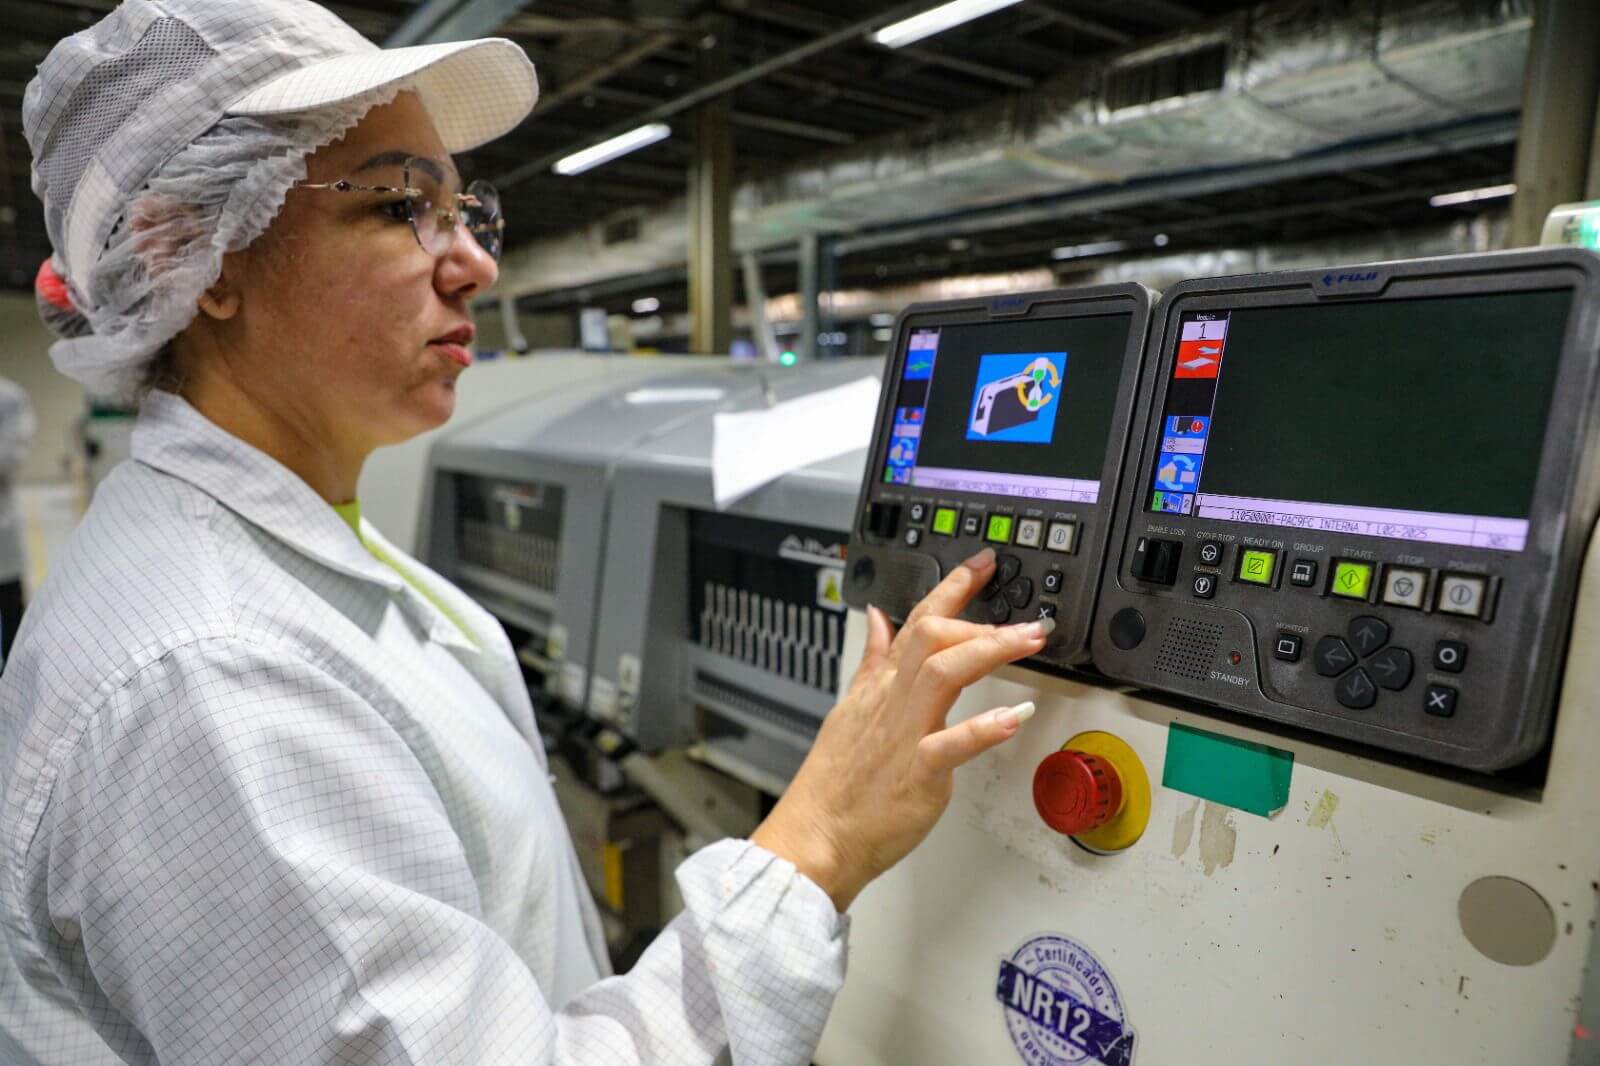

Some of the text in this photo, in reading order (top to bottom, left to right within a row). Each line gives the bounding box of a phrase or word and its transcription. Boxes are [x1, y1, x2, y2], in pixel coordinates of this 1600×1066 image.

[1198, 322, 1206, 339] 1
[1243, 536, 1284, 550] READY ON
[1293, 542, 1324, 554] GROUP
[1343, 547, 1374, 560] START
[1396, 554, 1424, 566] STOP
[1210, 670, 1250, 687] STANDBY
[1035, 947, 1104, 997] Certificado
[1011, 973, 1091, 1046] NR12
